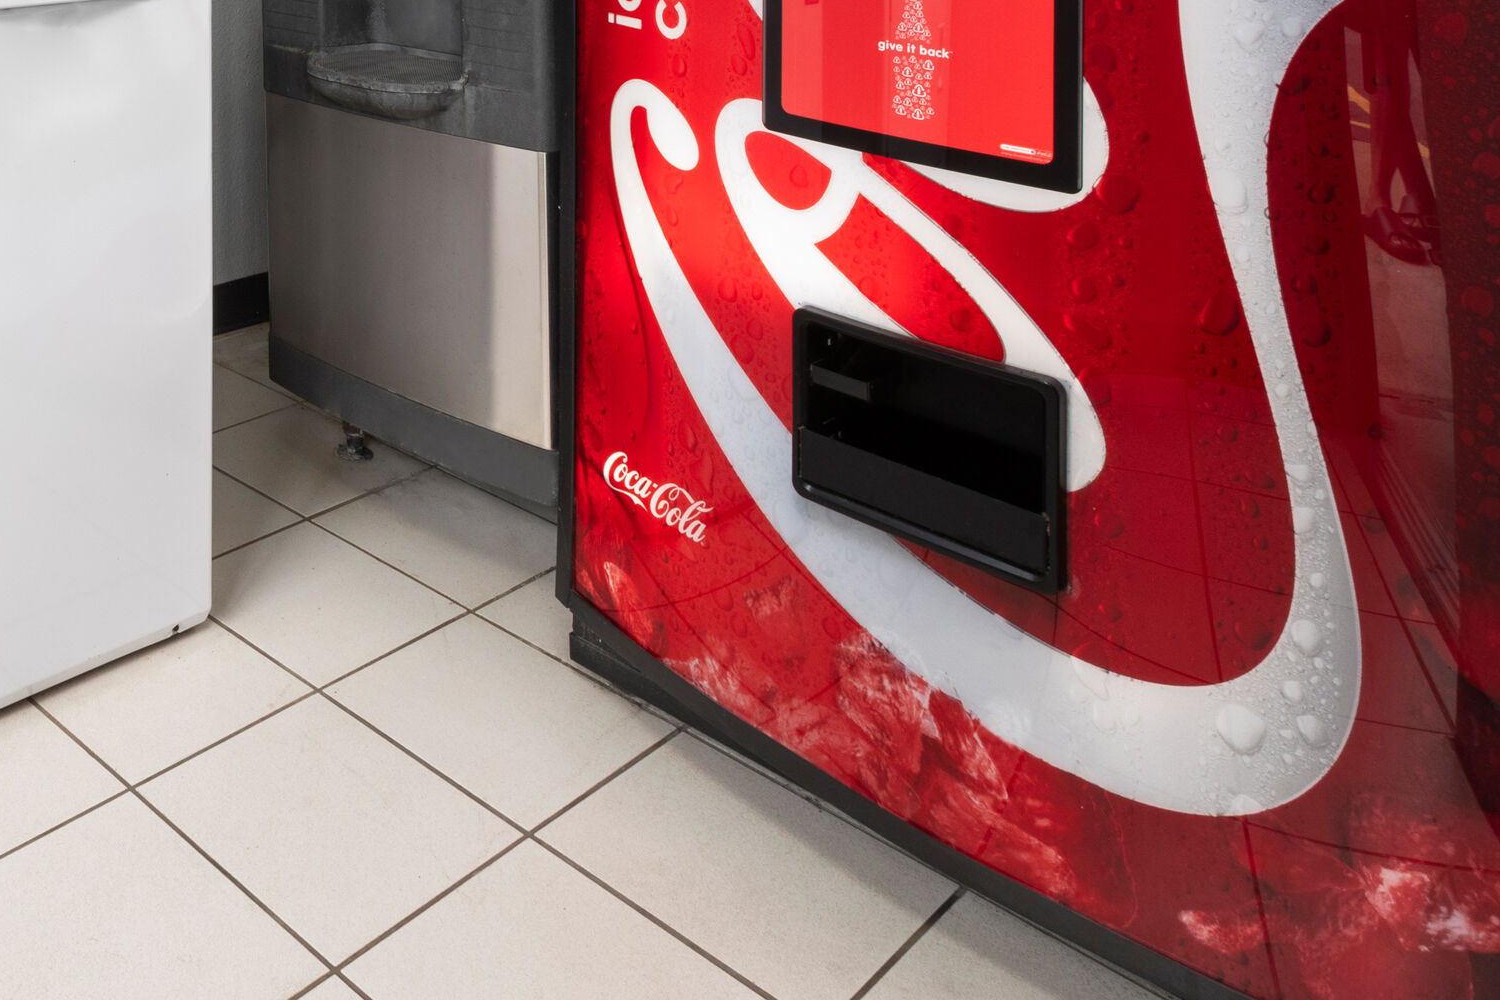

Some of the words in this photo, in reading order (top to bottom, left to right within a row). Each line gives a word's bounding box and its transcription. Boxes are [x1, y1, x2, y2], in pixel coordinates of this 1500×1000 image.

[877, 40, 903, 53] give
[907, 41, 916, 54] it
[919, 44, 950, 60] back
[603, 451, 714, 543] Coca-Cola
